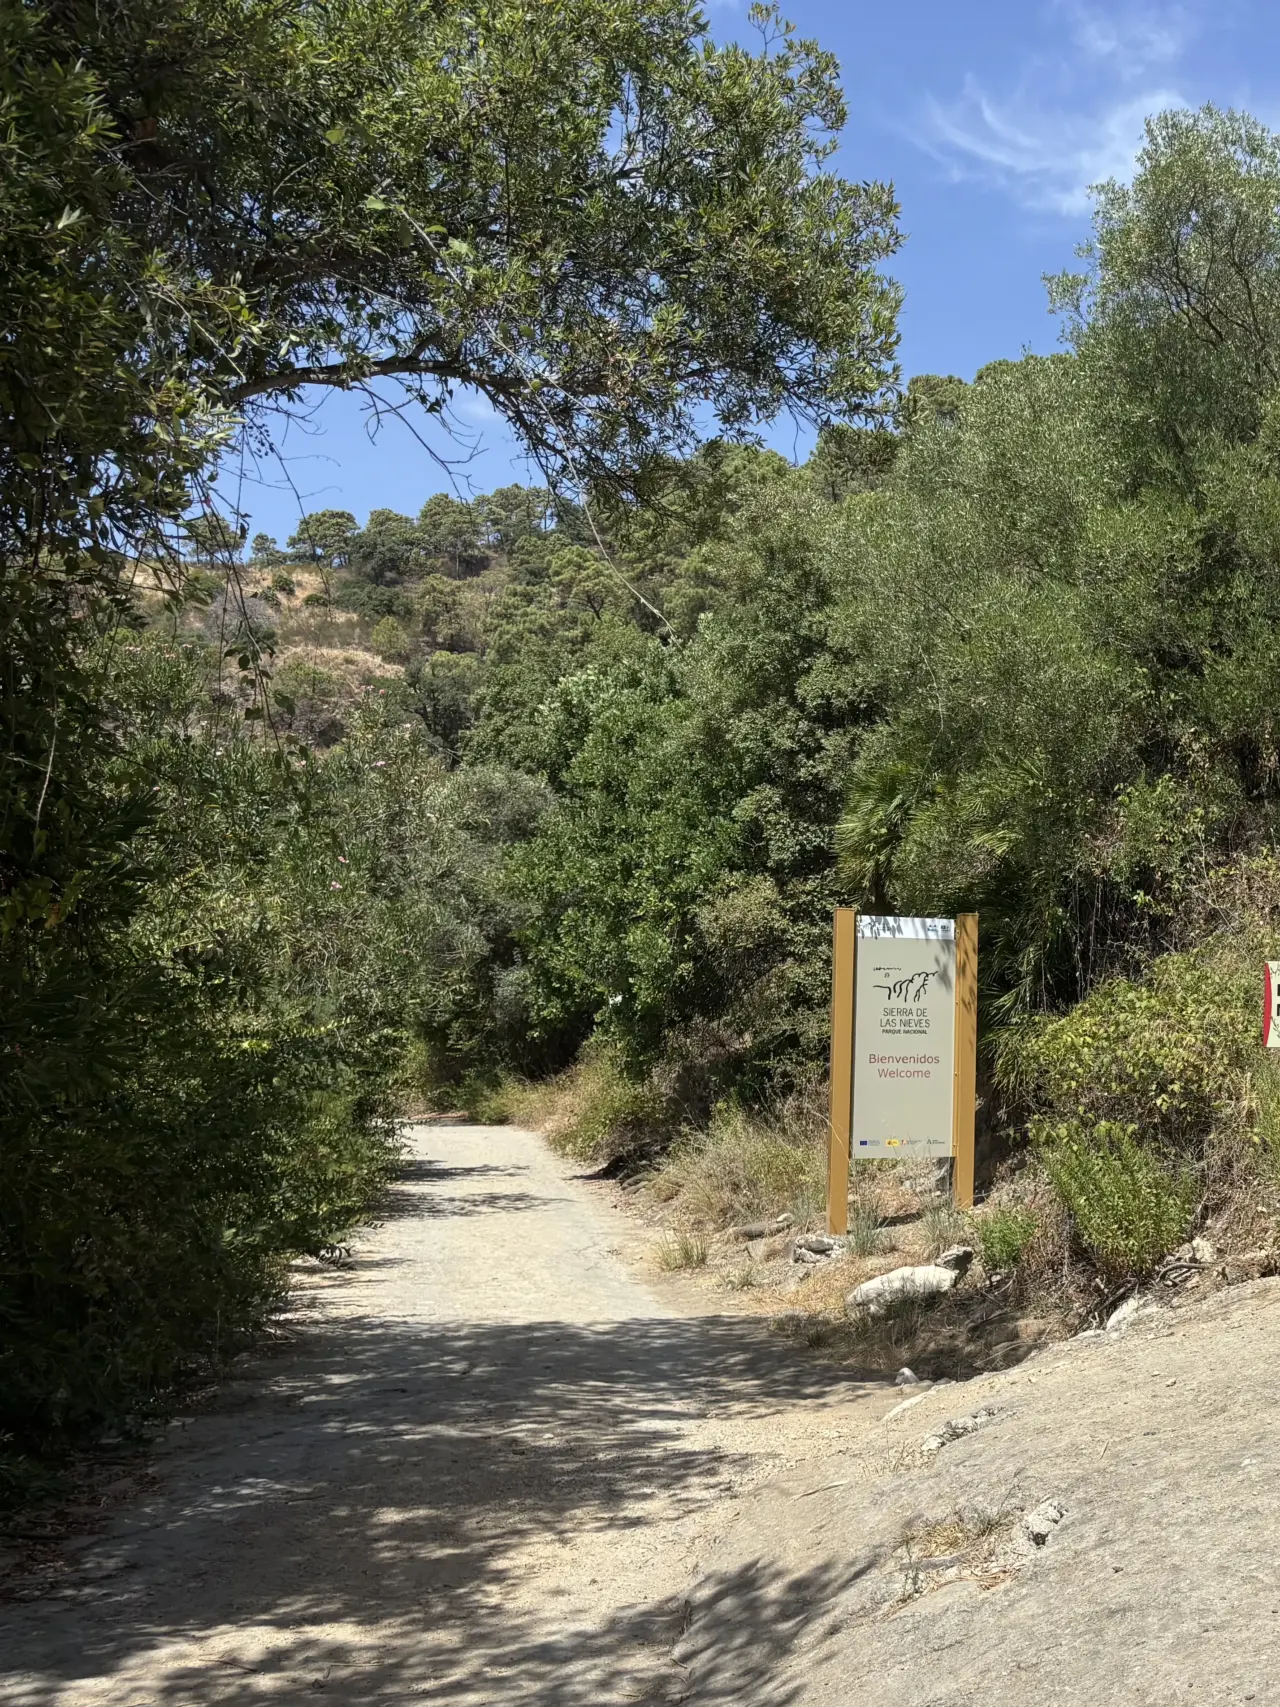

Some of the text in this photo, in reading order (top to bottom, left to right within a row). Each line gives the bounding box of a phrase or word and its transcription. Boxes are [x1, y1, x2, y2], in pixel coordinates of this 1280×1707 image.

[882, 1007, 928, 1017] SIERRA DE
[880, 1018, 931, 1028] LAS NIEVES
[869, 1053, 940, 1064] Bienvenidos
[878, 1068, 931, 1078] Welcome
